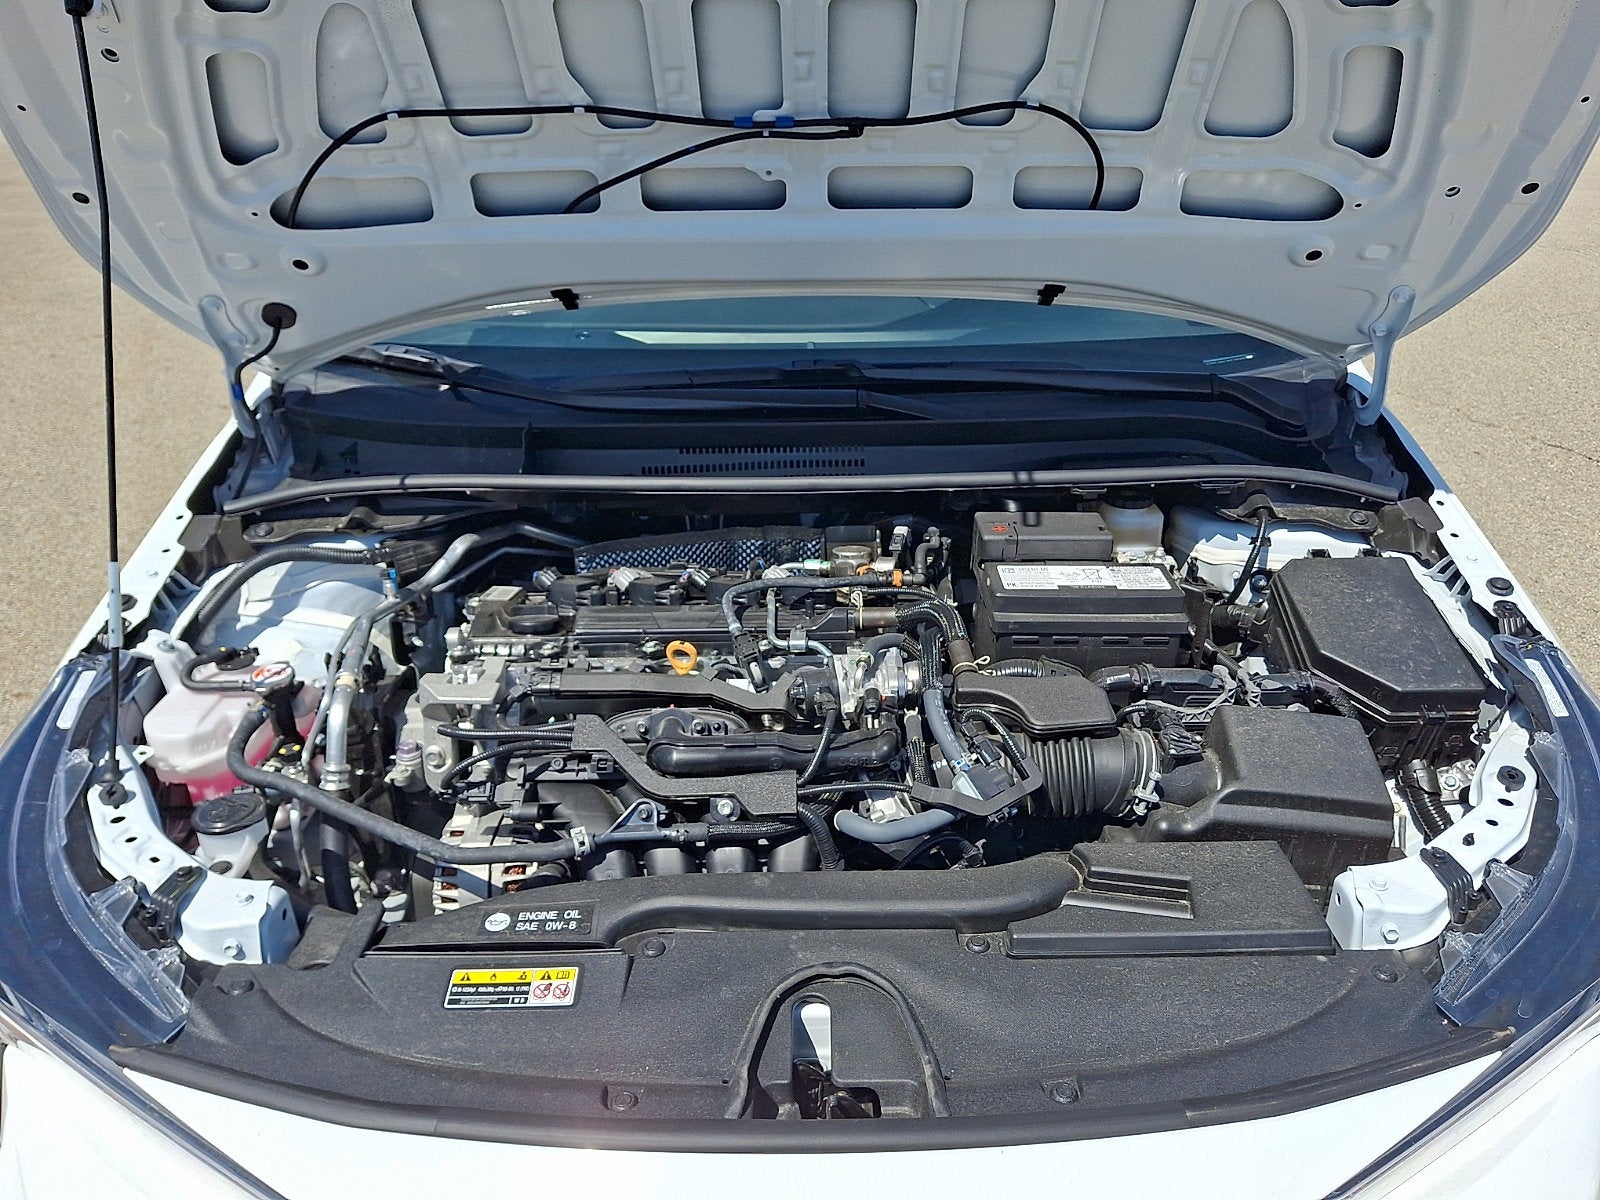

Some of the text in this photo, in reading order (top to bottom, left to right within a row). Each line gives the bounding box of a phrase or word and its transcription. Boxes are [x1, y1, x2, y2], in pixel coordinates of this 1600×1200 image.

[518, 910, 581, 920] ENGINE OIL
[515, 920, 577, 931] SAE 0W-8
